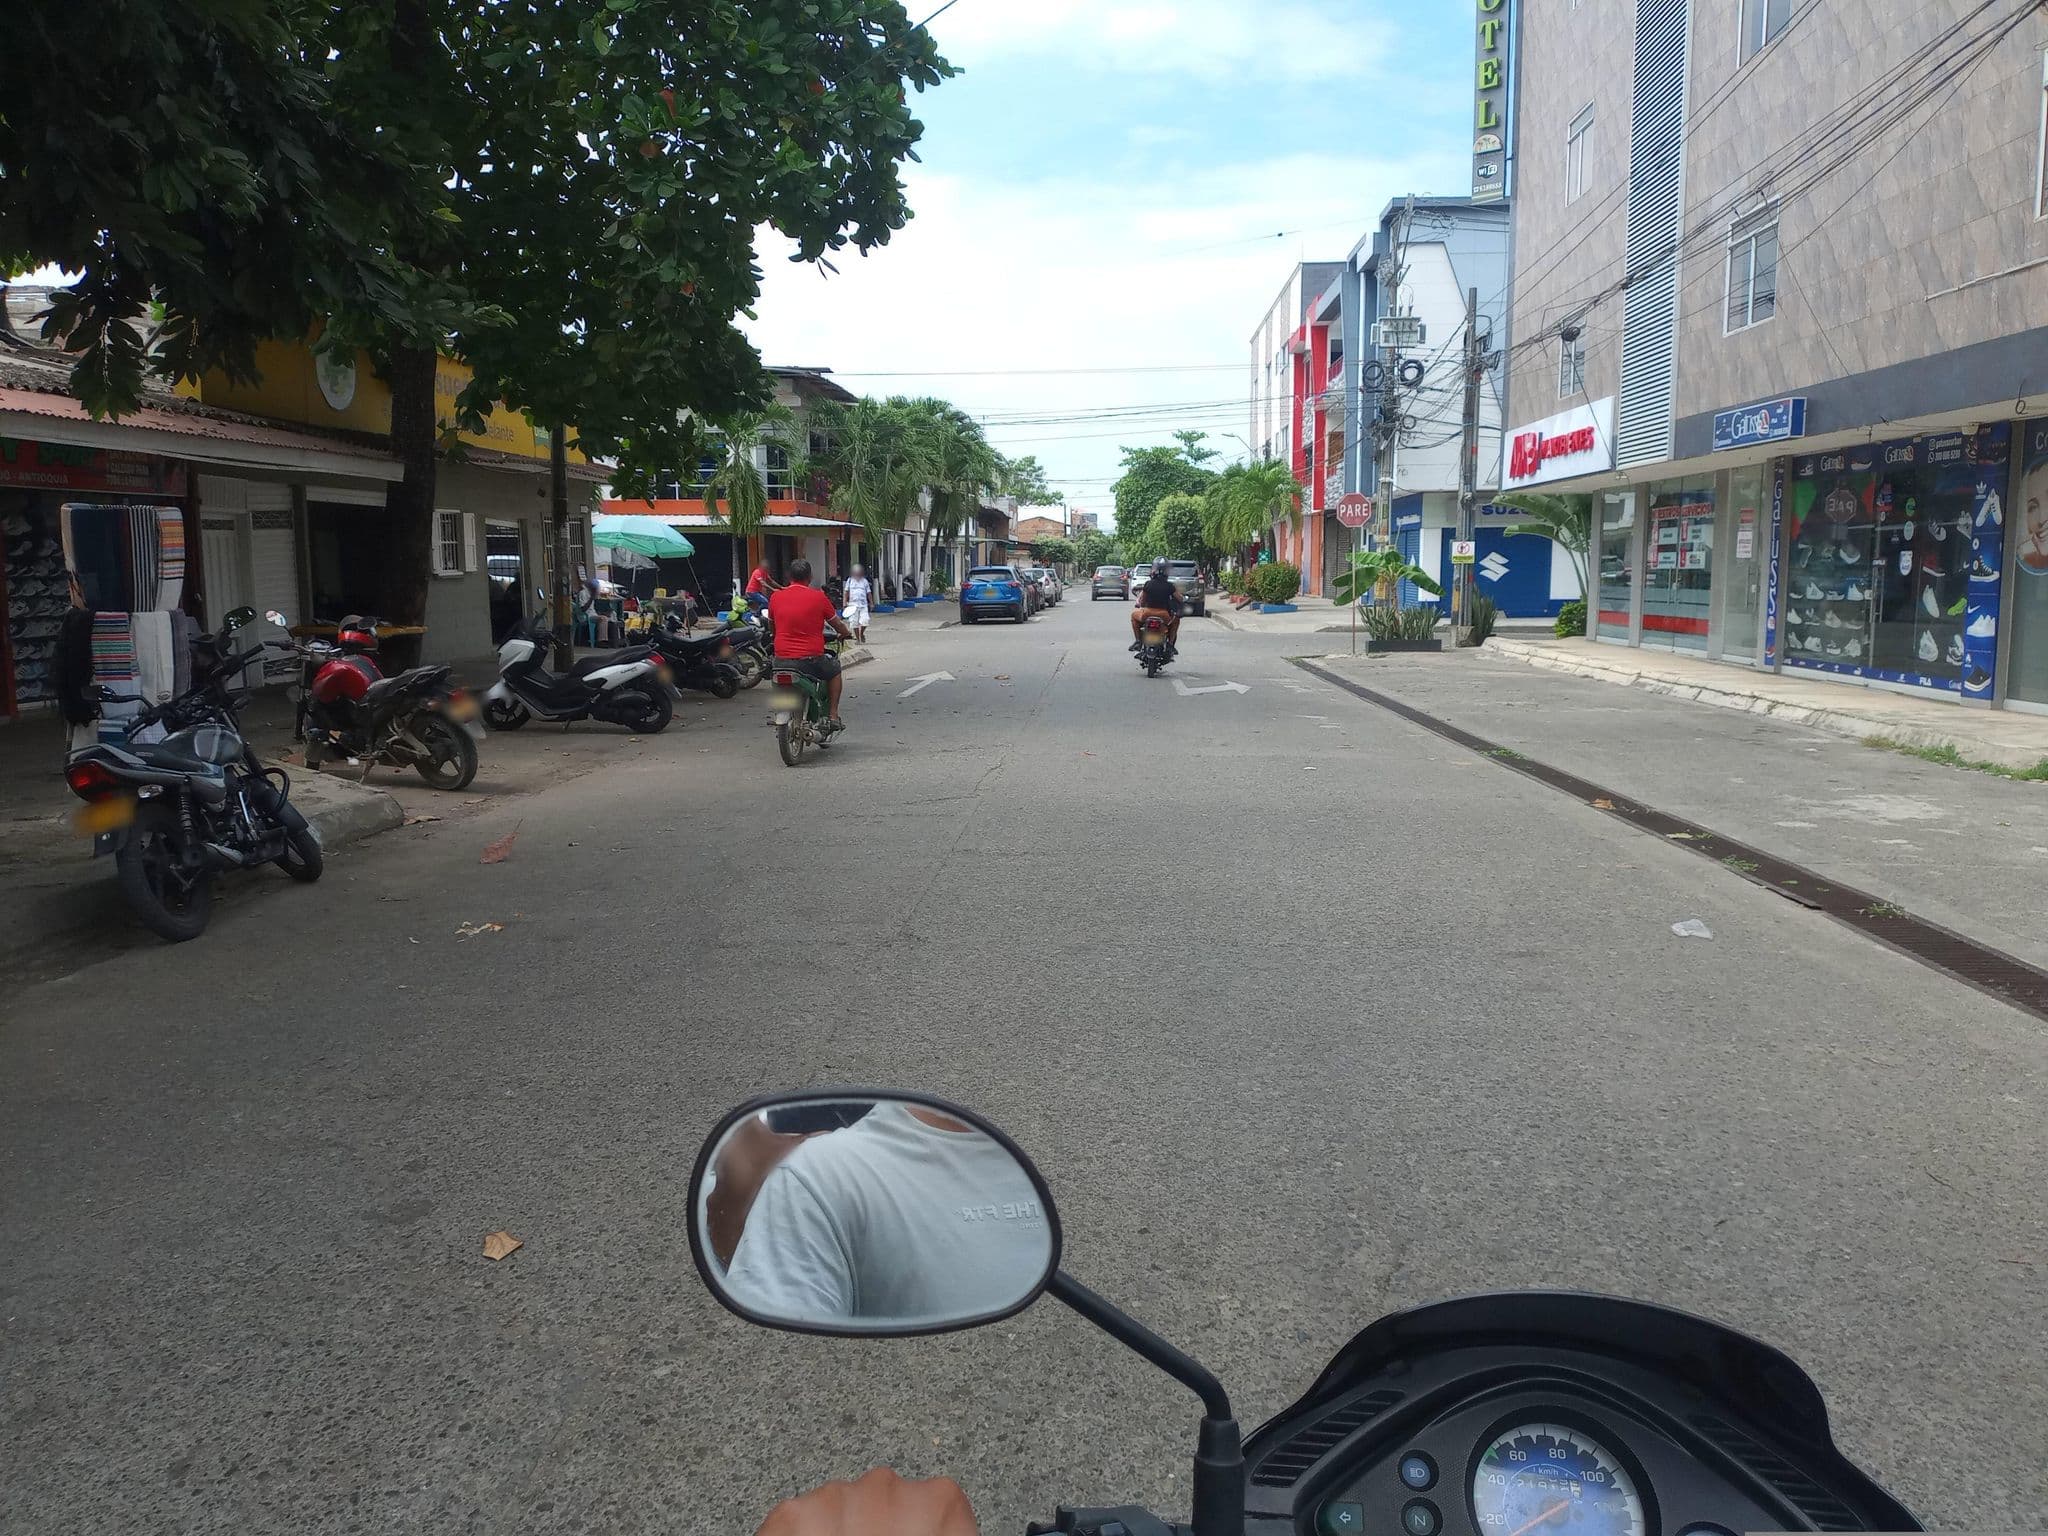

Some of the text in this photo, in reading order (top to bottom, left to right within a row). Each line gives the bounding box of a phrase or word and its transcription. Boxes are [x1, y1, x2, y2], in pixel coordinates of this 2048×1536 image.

[1340, 503, 1369, 518] PARE
[1481, 504, 1529, 515] SUZ
[1509, 1450, 1526, 1461] 60
[1549, 1448, 1566, 1460] 80
[1538, 1467, 1559, 1476] km/h
[1580, 1470, 1605, 1483] 100
[1488, 1474, 1505, 1486] 40
[1414, 1515, 1426, 1526] N
[1486, 1513, 1504, 1525] 20
